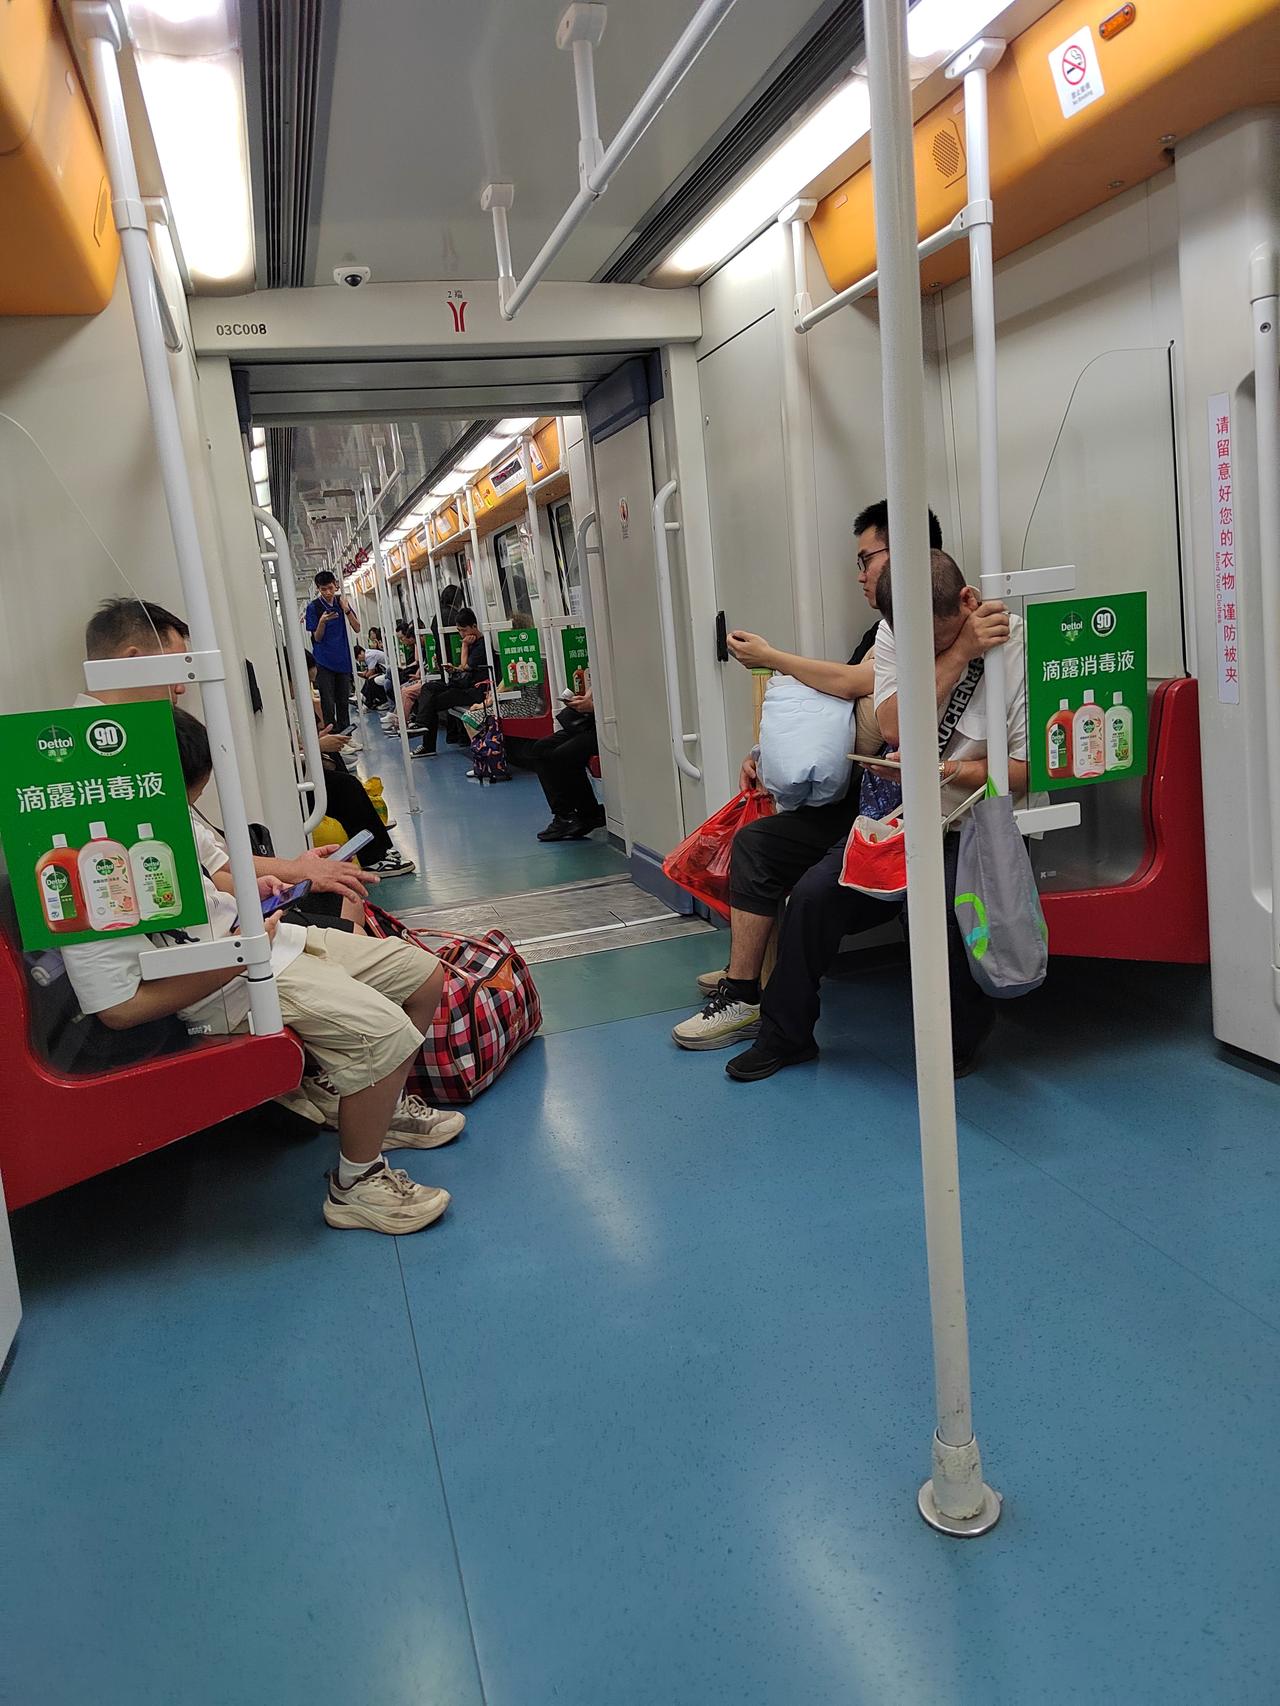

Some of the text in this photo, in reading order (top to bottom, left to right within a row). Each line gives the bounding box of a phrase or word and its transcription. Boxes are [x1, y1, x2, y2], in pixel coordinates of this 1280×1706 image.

[216, 323, 267, 336] 03C008
[1216, 416, 1238, 684] 请留意好您的衣物 谨防被夹
[1061, 621, 1083, 632] Dettol
[1096, 612, 1112, 629] 90
[1042, 650, 1135, 682] 滴露消毒液
[38, 736, 73, 750] Dettol
[94, 726, 118, 746] 90
[15, 771, 166, 814] 滴露消毒液
[46, 876, 68, 887] Dettol
